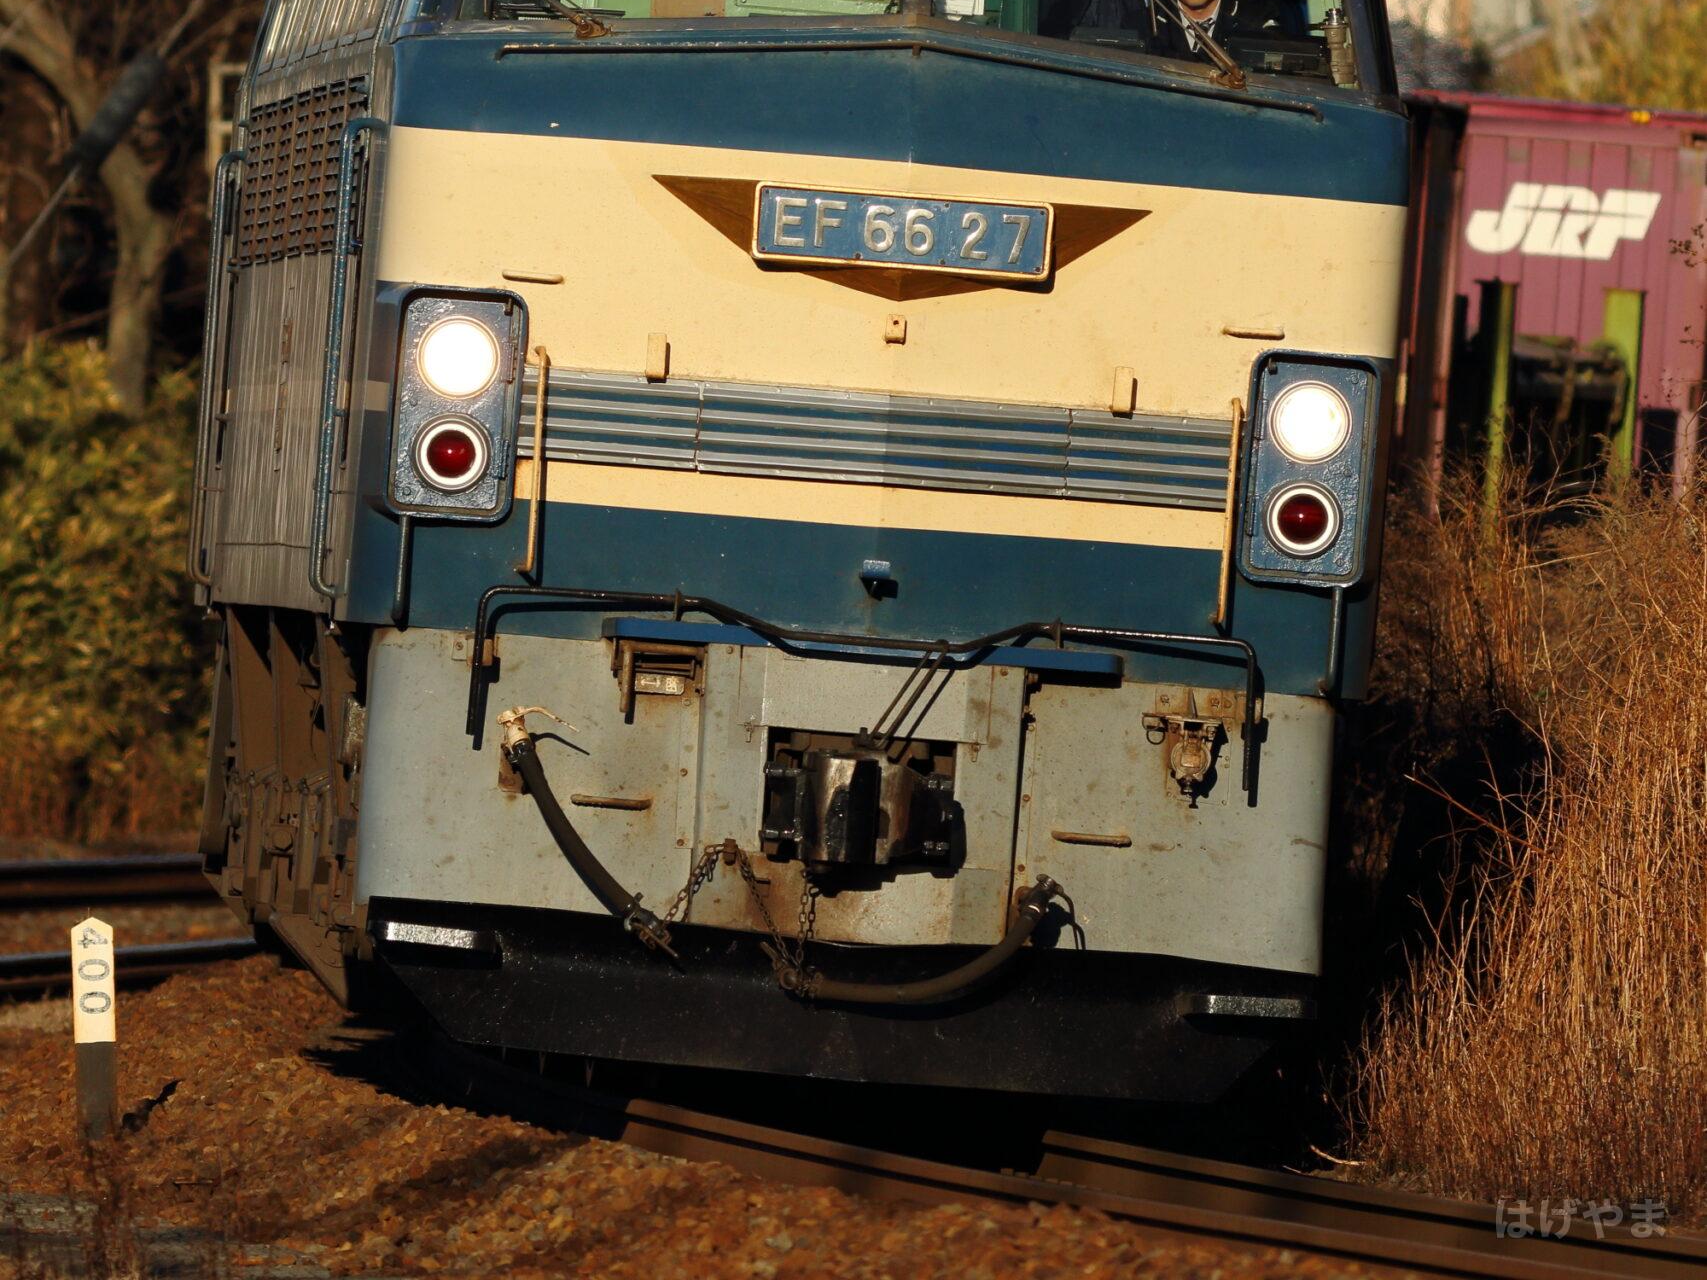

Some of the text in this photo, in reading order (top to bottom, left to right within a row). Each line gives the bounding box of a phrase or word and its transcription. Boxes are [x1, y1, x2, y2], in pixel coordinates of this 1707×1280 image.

[774, 196, 1032, 264] EF 66 27
[1465, 182, 1661, 260] JRF
[78, 927, 111, 1014] 400
